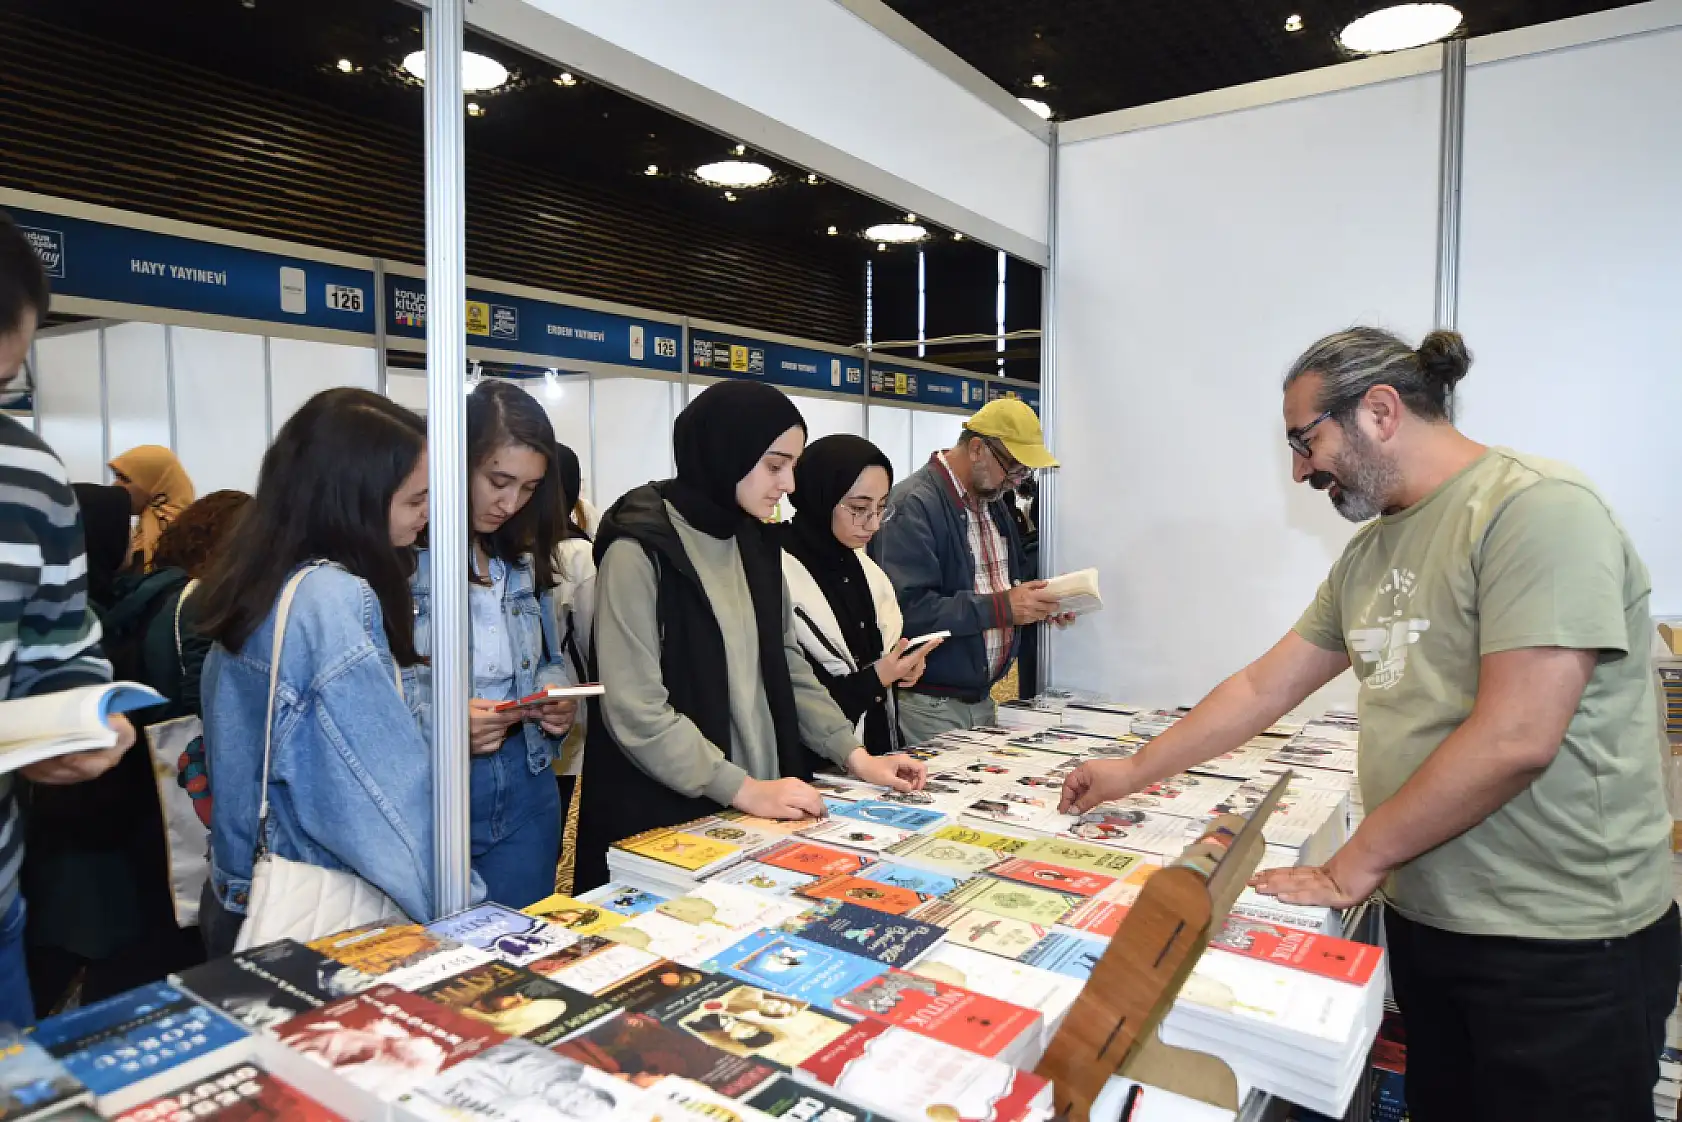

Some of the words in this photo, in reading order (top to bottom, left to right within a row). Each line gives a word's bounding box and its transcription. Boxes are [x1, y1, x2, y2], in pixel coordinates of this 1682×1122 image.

[130, 259, 166, 276] HAYY
[169, 264, 227, 287] YAYINEVİ
[331, 292, 361, 311] 126
[547, 325, 573, 338] ERDEM
[656, 341, 675, 356] 125
